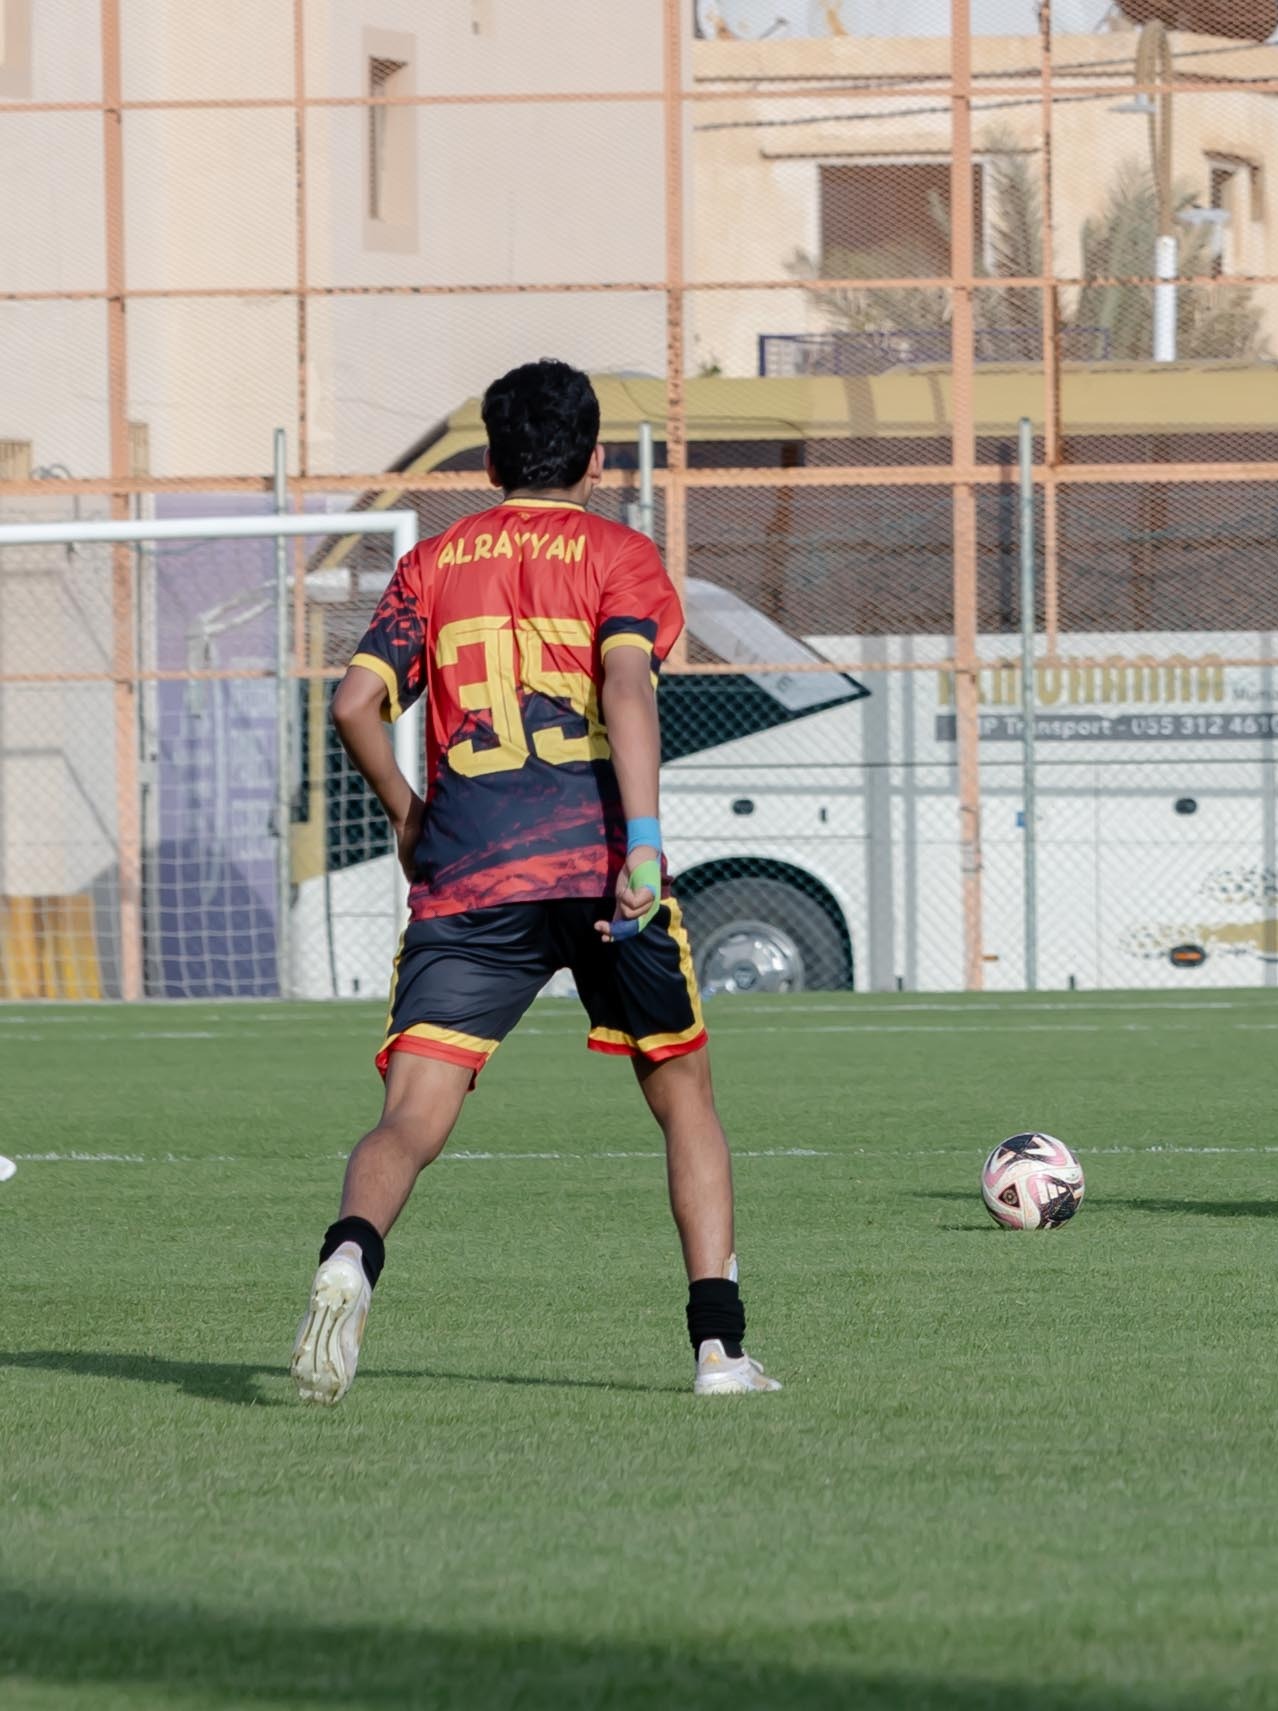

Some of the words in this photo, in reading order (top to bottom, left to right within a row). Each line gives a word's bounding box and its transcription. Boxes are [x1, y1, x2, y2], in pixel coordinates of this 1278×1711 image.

[438, 530, 586, 569] ALRAYYAN
[436, 616, 611, 778] 35
[1004, 716, 1112, 739] Trnsport
[1180, 715, 1224, 735] 312
